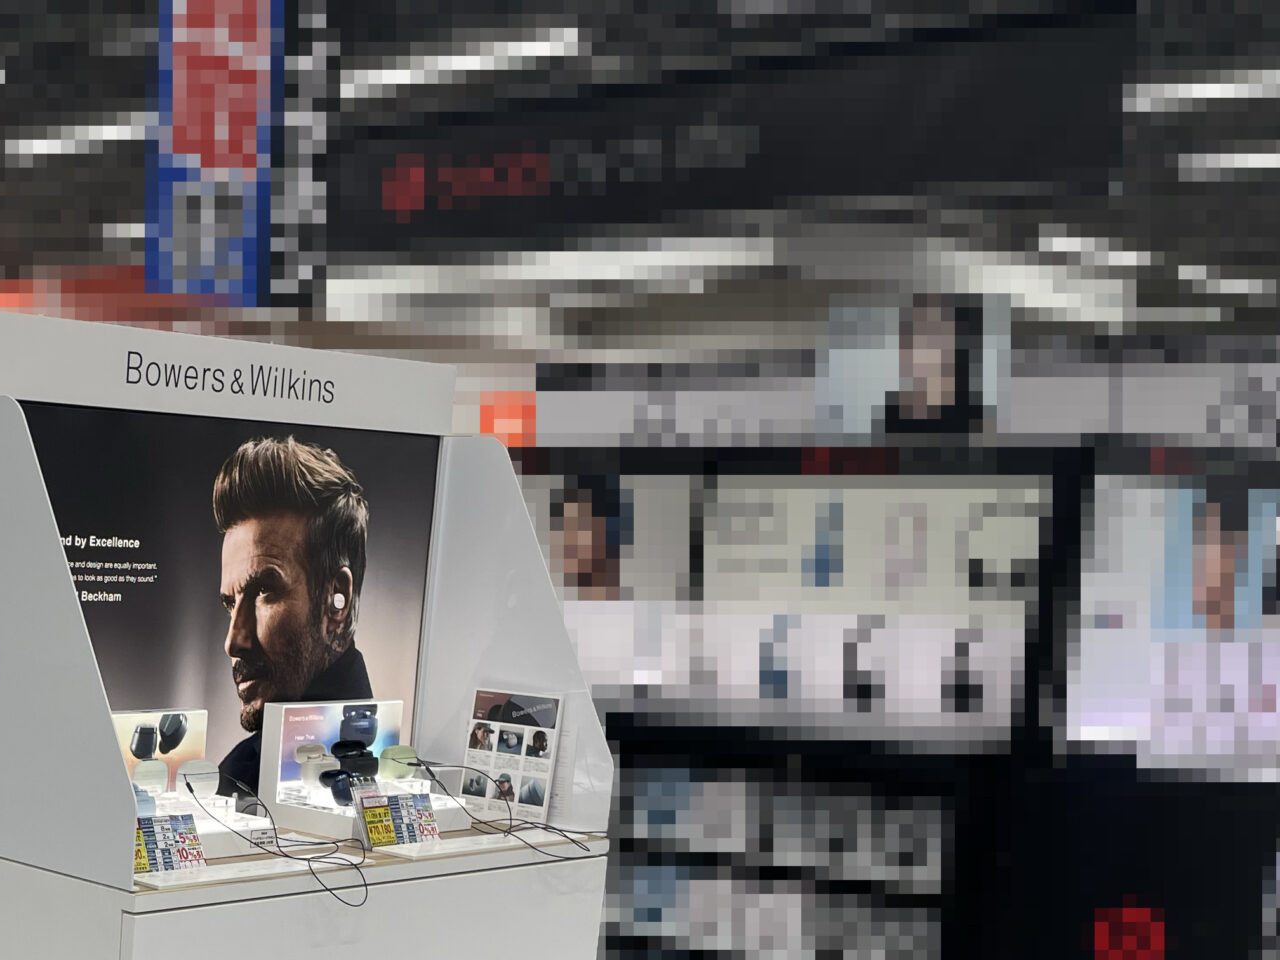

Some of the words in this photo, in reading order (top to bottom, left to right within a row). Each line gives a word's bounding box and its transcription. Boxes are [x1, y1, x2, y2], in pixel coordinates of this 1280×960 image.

[125, 350, 225, 393] Bowers
[250, 363, 335, 404] Wilkins
[60, 535, 72, 546] nd
[74, 535, 87, 549] by
[89, 535, 140, 548] Excellence
[81, 590, 122, 601] Beckham
